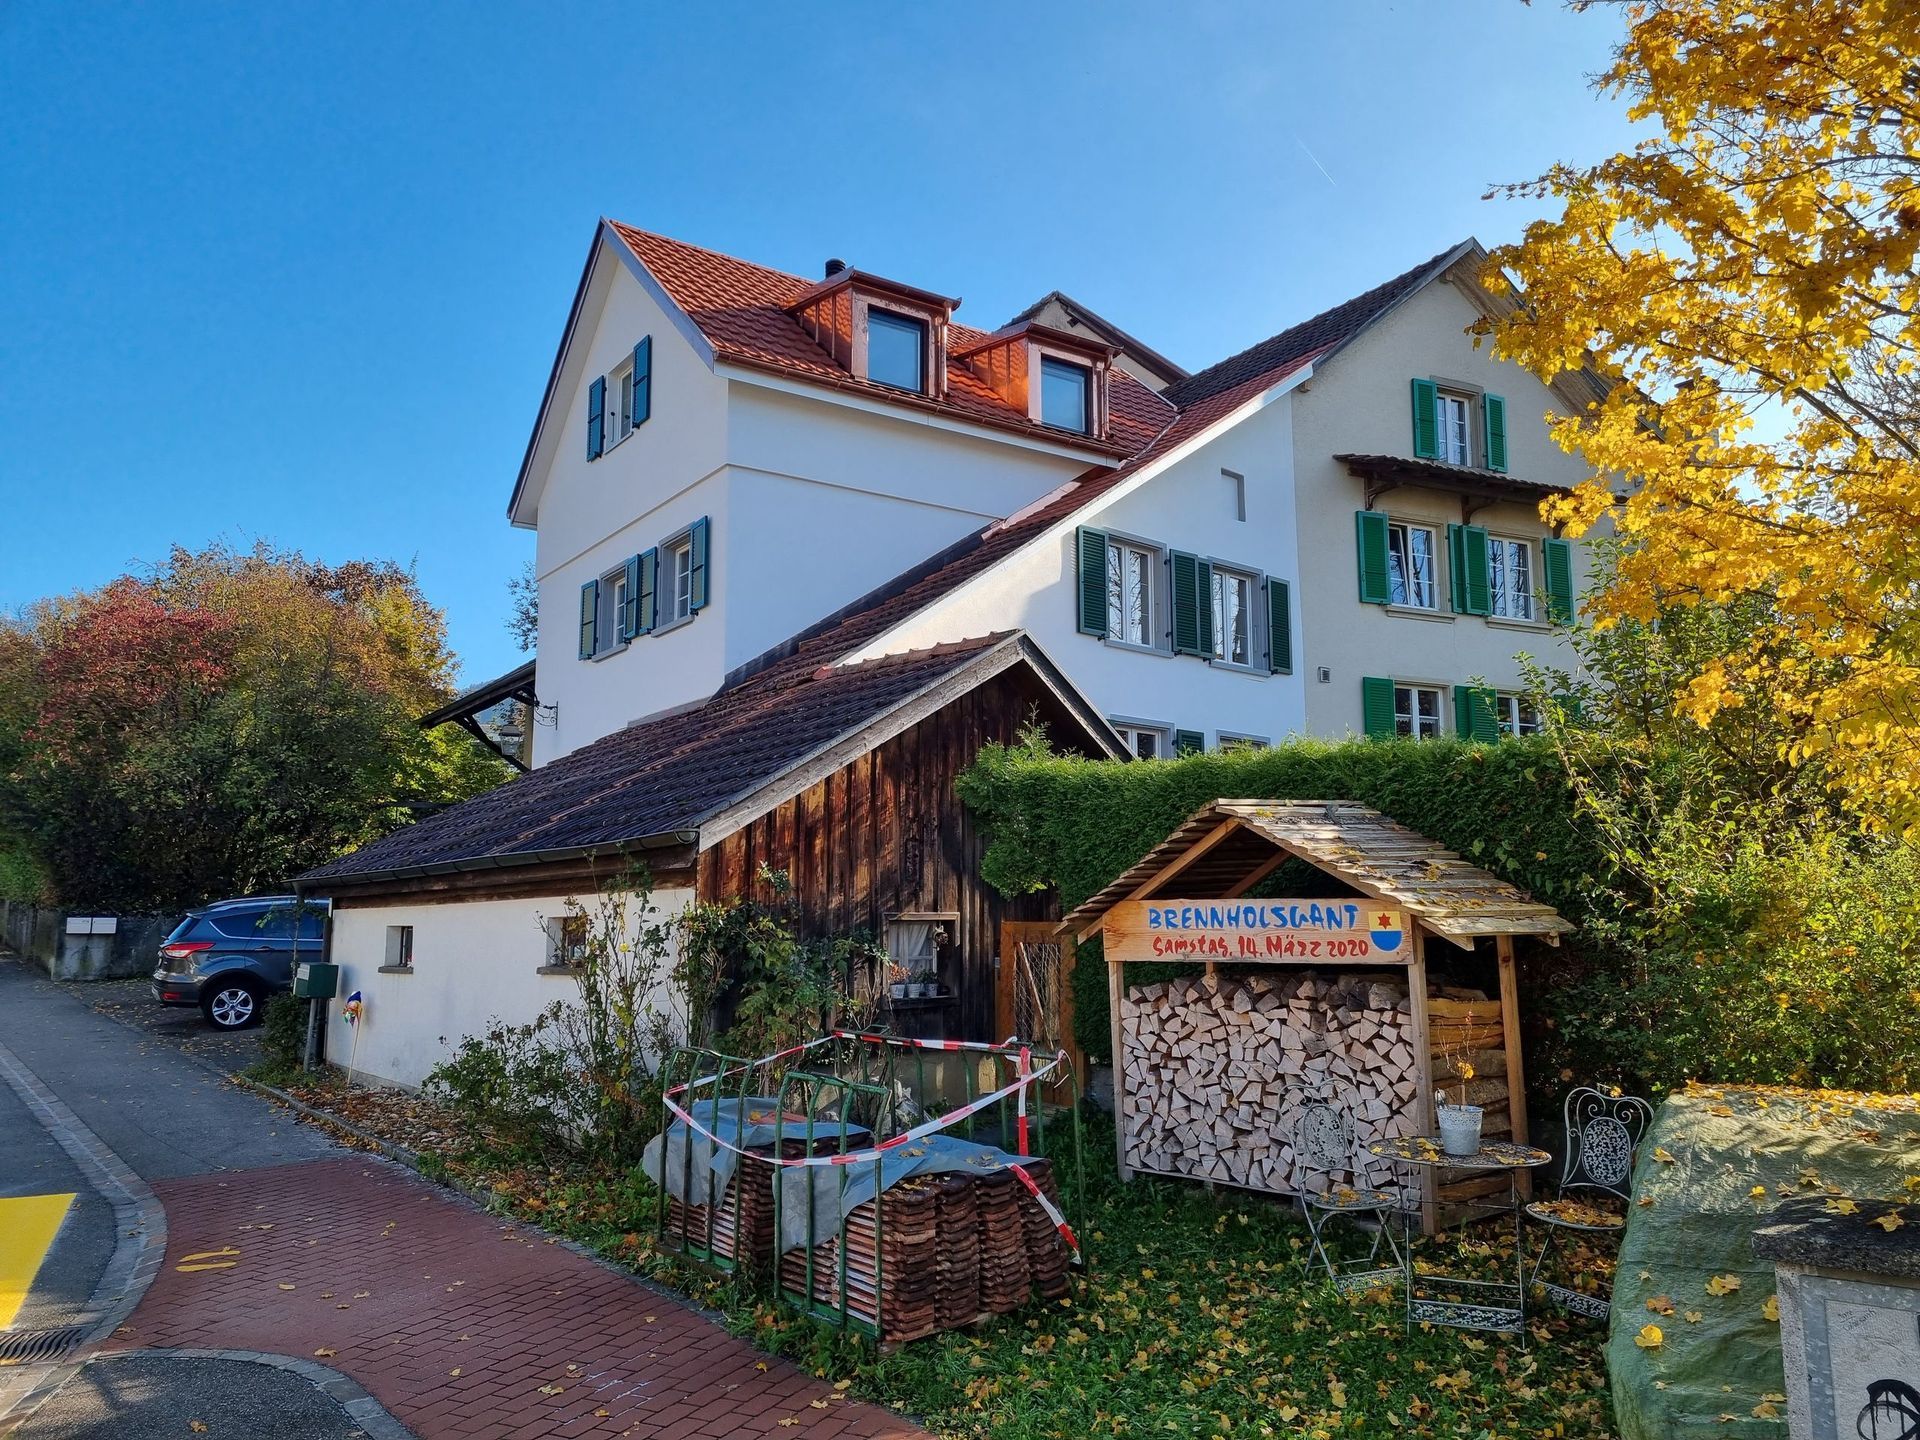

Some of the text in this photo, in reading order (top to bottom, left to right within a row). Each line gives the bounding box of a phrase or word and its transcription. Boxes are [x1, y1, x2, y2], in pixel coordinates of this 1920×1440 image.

[1238, 935, 1263, 958] 14.
[1265, 934, 1322, 958] März
[1326, 939, 1369, 957] 2020
